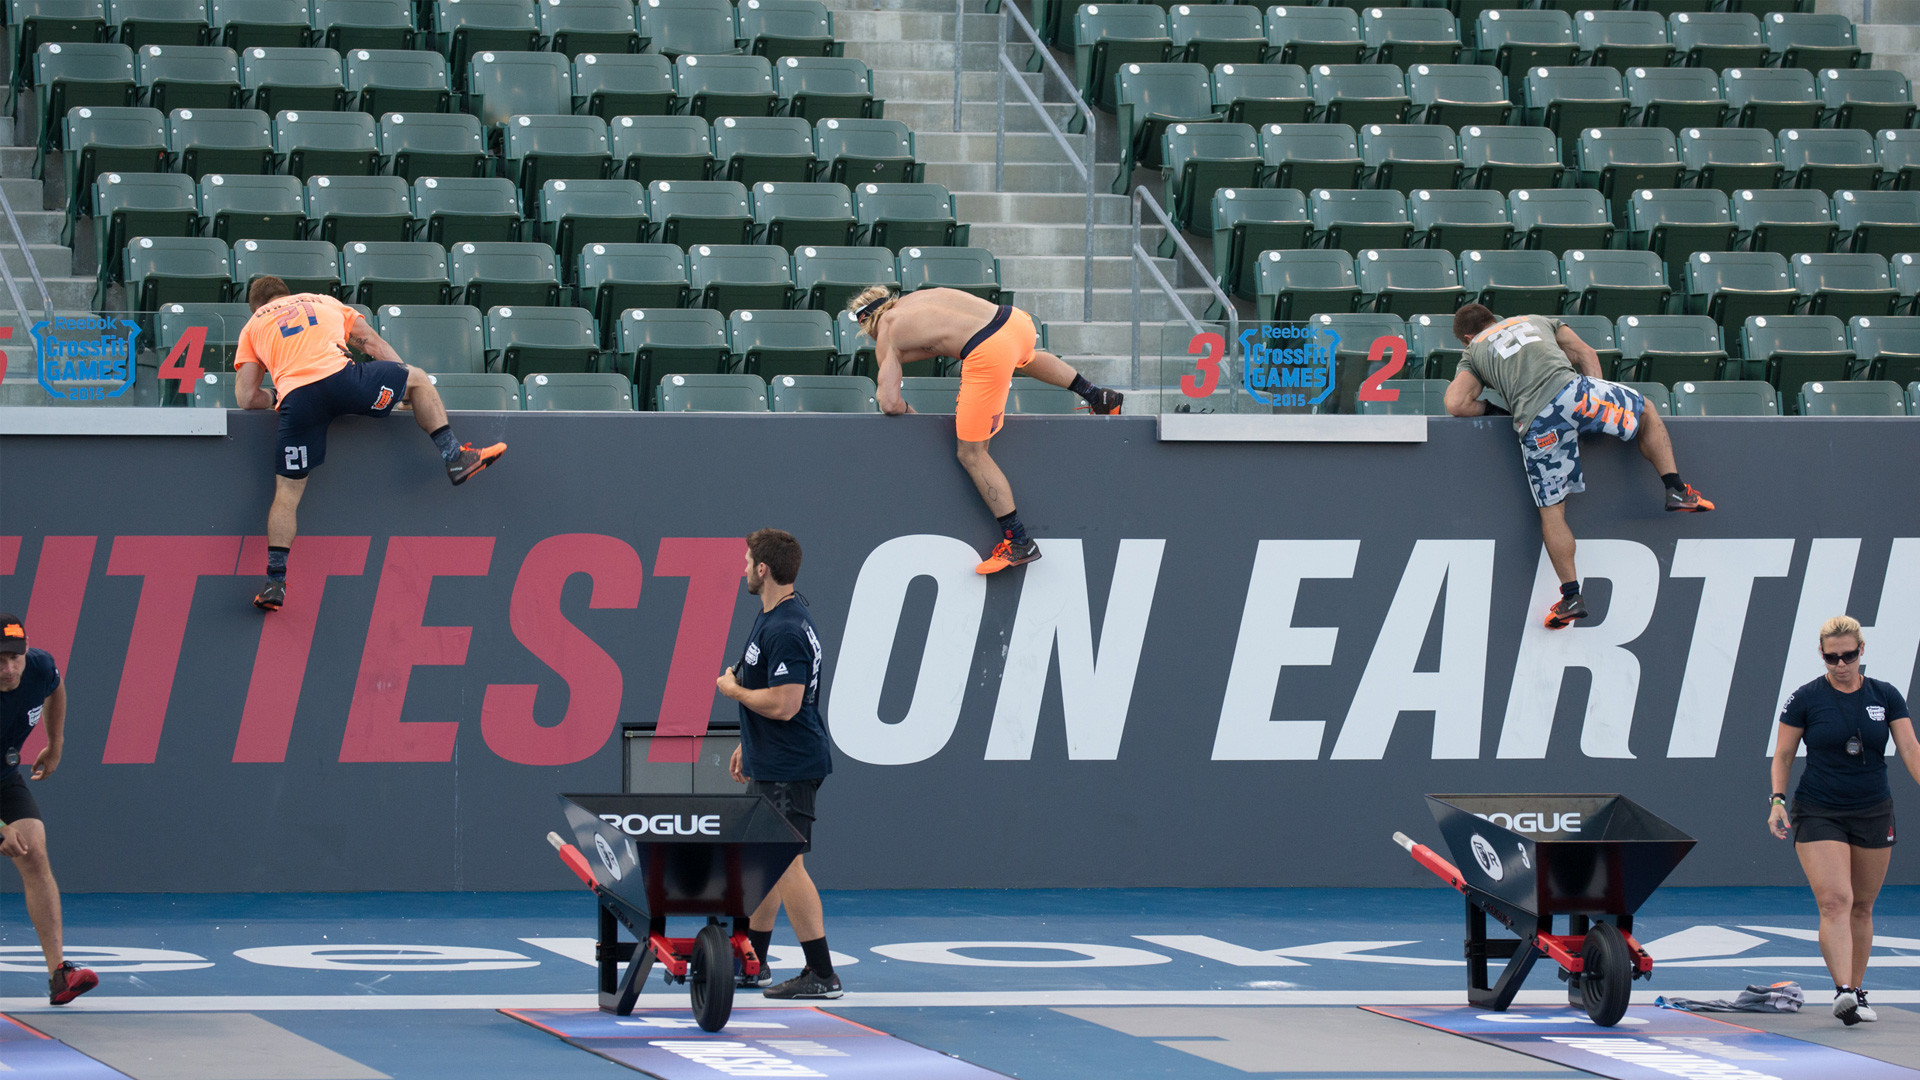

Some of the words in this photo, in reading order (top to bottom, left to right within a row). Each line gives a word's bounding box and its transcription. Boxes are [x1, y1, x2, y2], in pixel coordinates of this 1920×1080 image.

[55, 316, 117, 330] Reebok
[274, 302, 318, 338] 21
[1261, 325, 1319, 339] Reebok
[46, 335, 126, 357] CrossFit
[1488, 322, 1543, 360] 22
[157, 326, 208, 394] 4
[1180, 332, 1226, 399] 3
[1253, 343, 1327, 365] CrossFit
[46, 360, 127, 381] GAMES
[1252, 367, 1327, 388] GAMES
[1358, 335, 1408, 402] 2
[69, 387, 105, 401] 2015
[1273, 393, 1306, 407] 2015
[1574, 393, 1634, 431] BAILEY
[284, 445, 308, 470] 21
[1542, 475, 1570, 500] 22
[0, 533, 745, 765] ITTEST
[830, 535, 1166, 766] ON
[1211, 537, 1920, 762] EARTH
[1473, 812, 1582, 833] OGUE
[1517, 841, 1531, 870] 3
